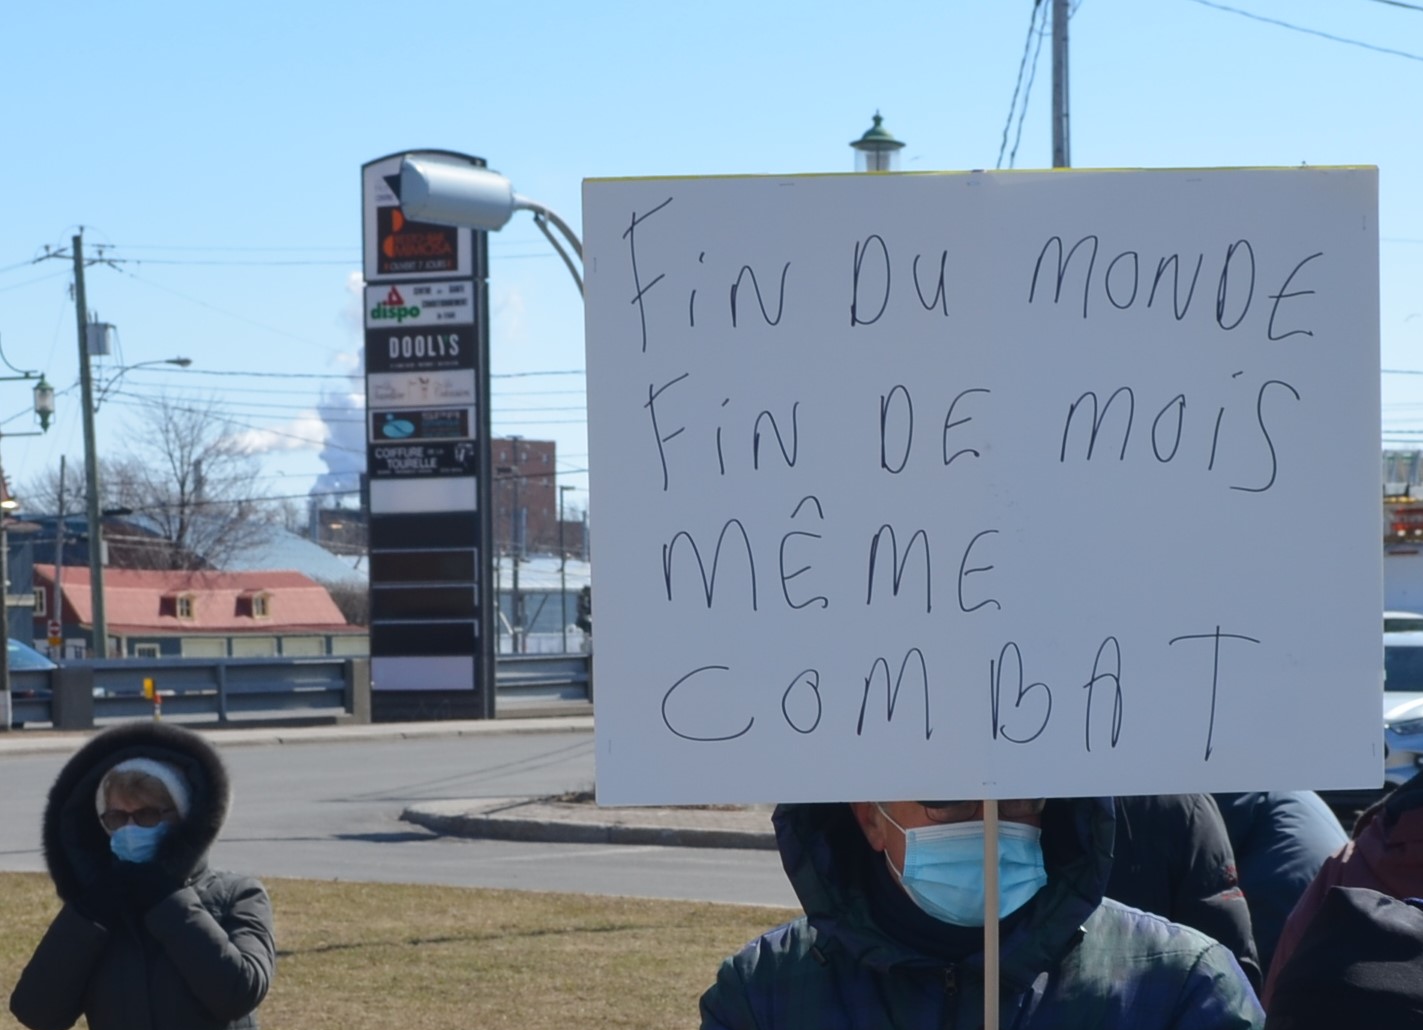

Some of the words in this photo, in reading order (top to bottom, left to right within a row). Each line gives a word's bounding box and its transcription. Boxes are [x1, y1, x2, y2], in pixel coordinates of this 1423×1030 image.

[371, 301, 421, 323] dispo
[851, 235, 949, 327] DU
[1029, 235, 1323, 340] MONDE
[374, 446, 425, 459] COIFFURE
[387, 457, 437, 470] TOURELLE
[881, 385, 991, 473] DE
[663, 496, 1001, 613] MÊME
[661, 626, 1261, 761] COMBAT
